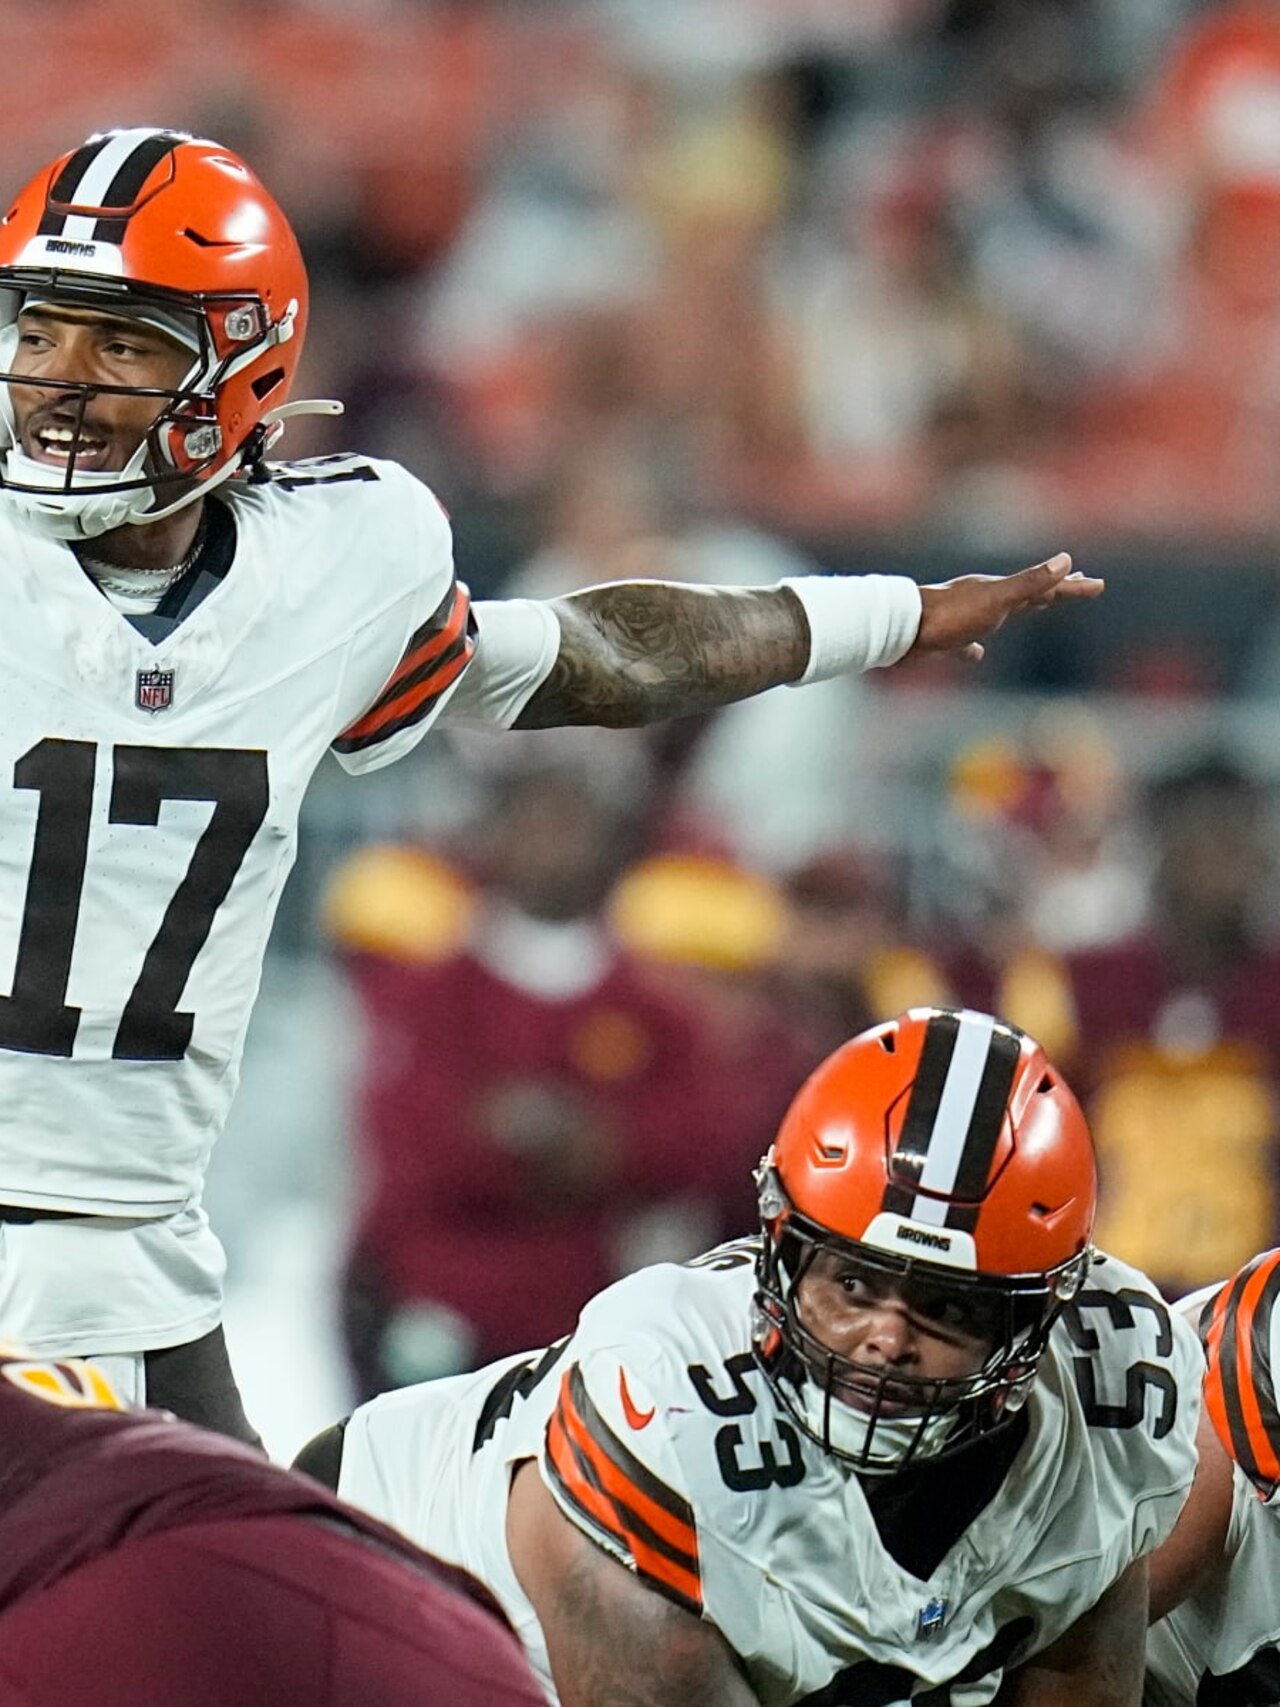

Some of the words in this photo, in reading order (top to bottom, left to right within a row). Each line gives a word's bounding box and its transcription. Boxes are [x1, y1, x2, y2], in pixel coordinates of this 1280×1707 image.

[45, 239, 96, 257] BROWNS
[142, 686, 169, 707] NFL
[896, 1225, 951, 1252] BROWNS
[1062, 1287, 1178, 1440] 53
[686, 1351, 807, 1493] 53
